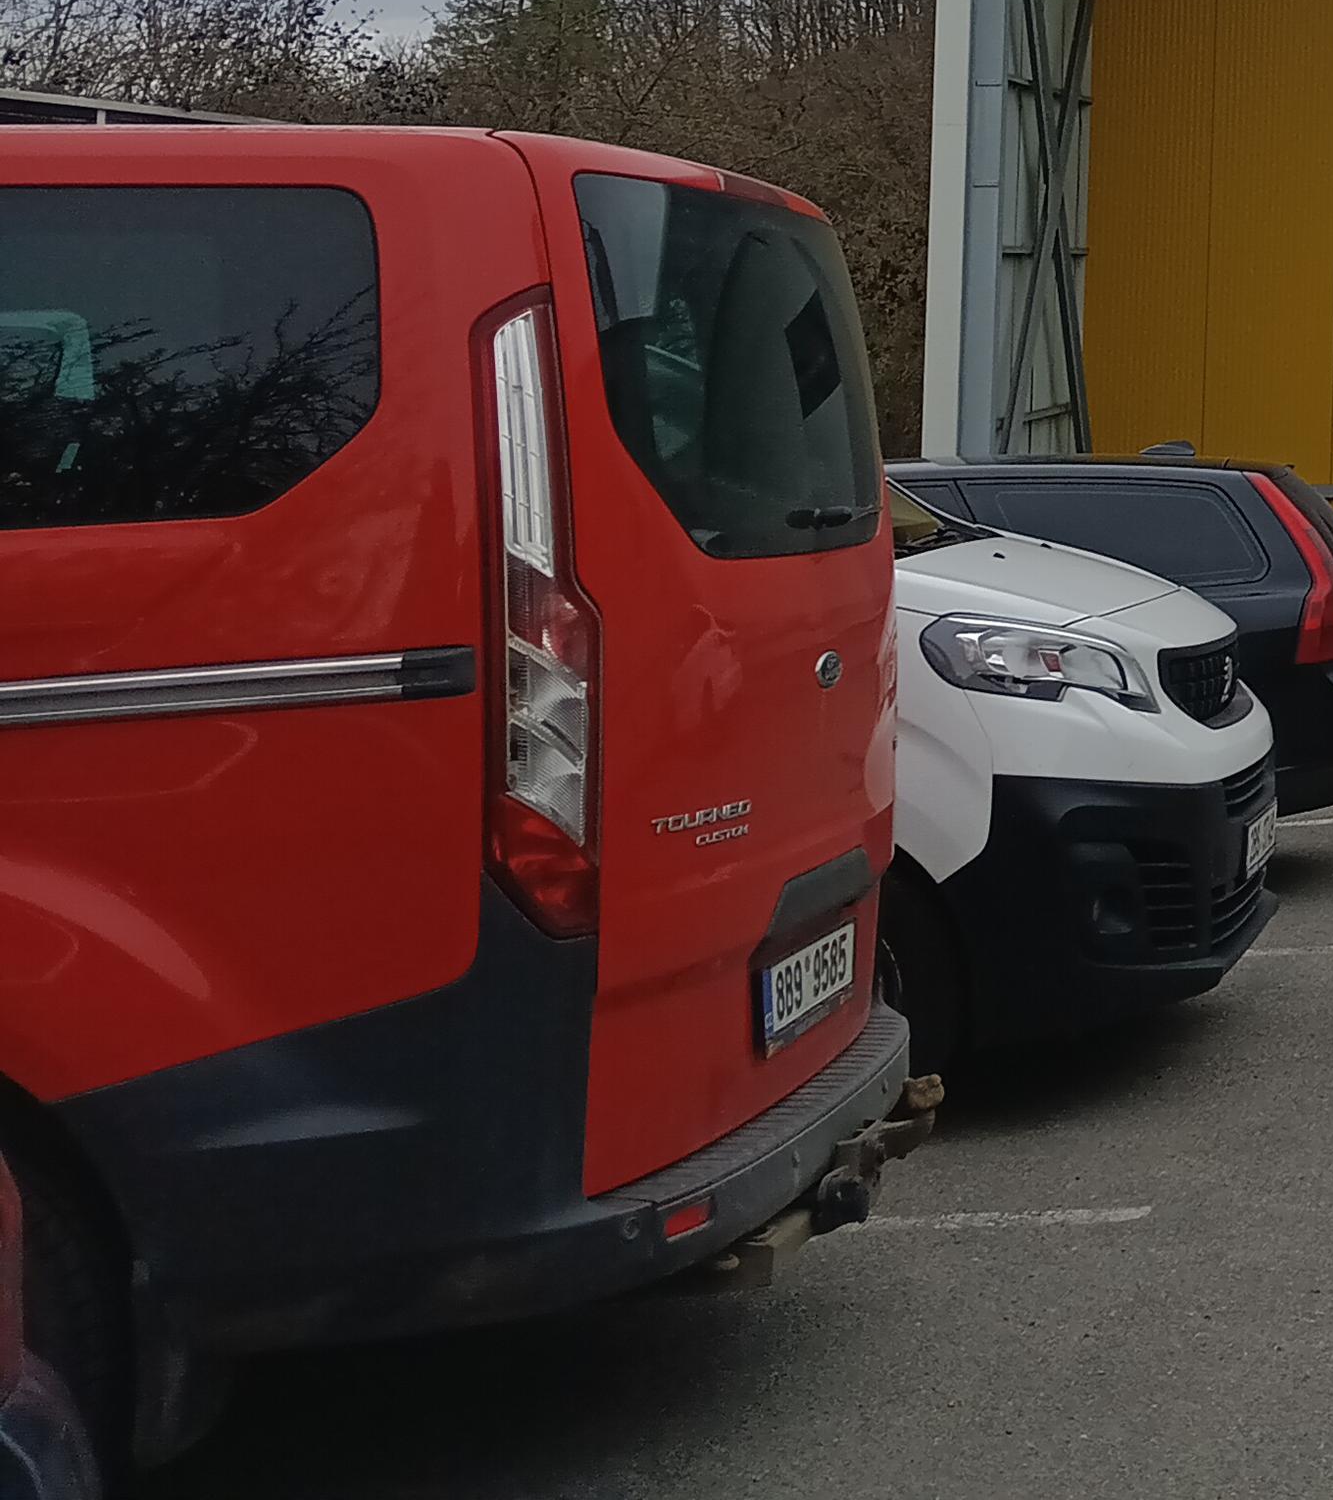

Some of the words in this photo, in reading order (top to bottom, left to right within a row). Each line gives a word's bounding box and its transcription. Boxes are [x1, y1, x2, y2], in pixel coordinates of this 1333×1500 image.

[651, 799, 752, 835] TOURNEO
[775, 960, 803, 1021] 8B9
[813, 932, 848, 998] 9585
